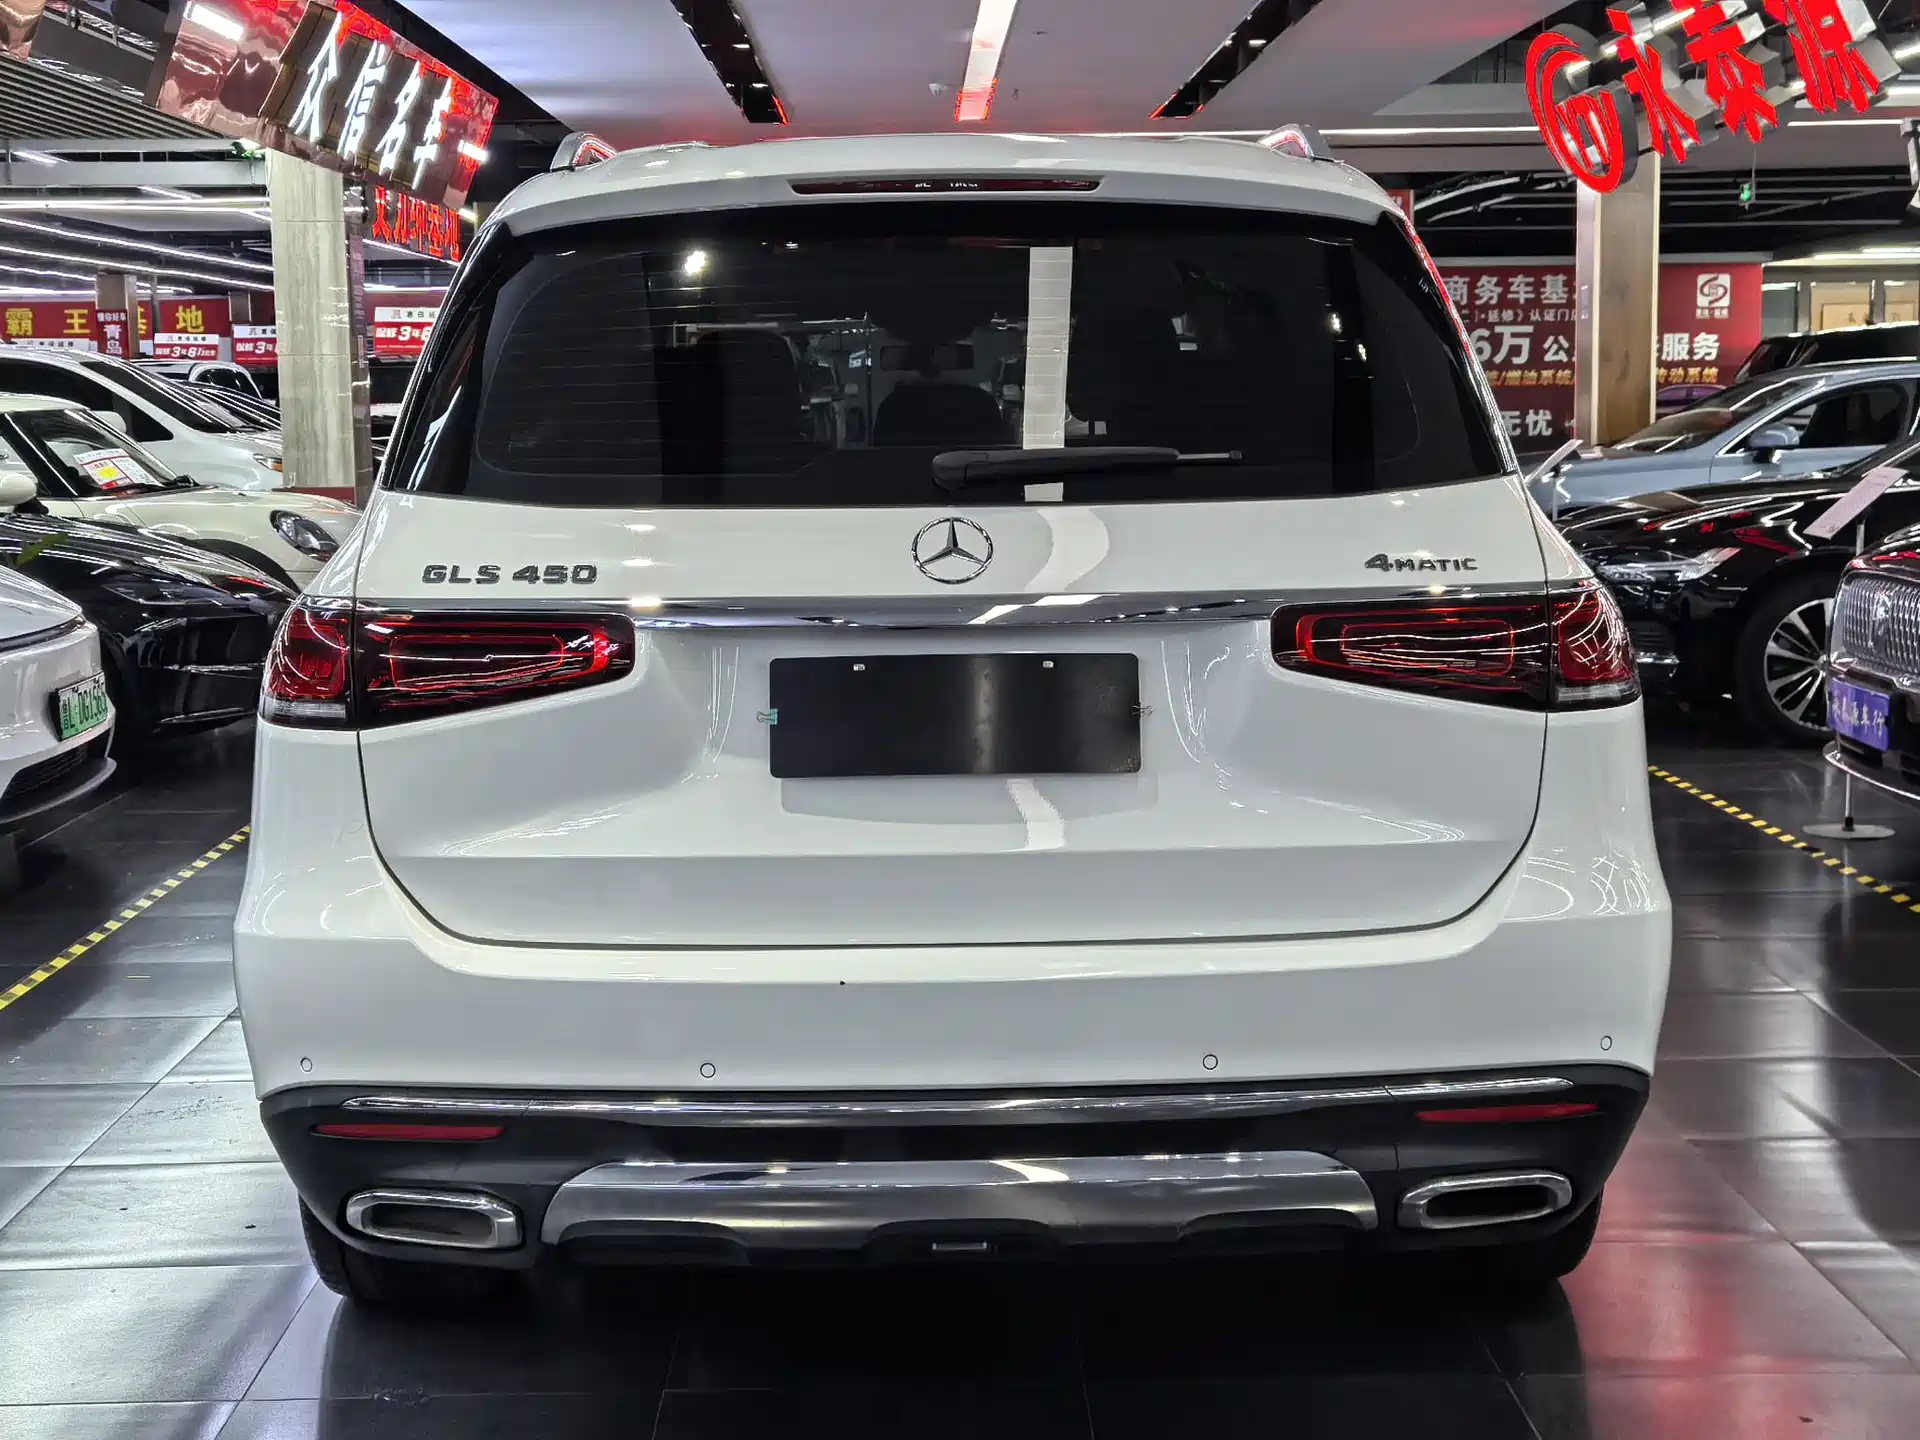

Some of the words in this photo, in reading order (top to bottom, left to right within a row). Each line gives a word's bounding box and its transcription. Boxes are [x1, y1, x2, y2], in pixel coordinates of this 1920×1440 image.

[288, 11, 453, 190] 众信名车
[1443, 273, 1576, 305] 商务车基
[1470, 325, 1576, 364] 6万公
[1656, 332, 1720, 360] 服务
[1500, 409, 1553, 437] 无忧
[422, 564, 501, 584] GLS
[512, 564, 598, 584] 450
[1364, 553, 1478, 572] 4MATIC
